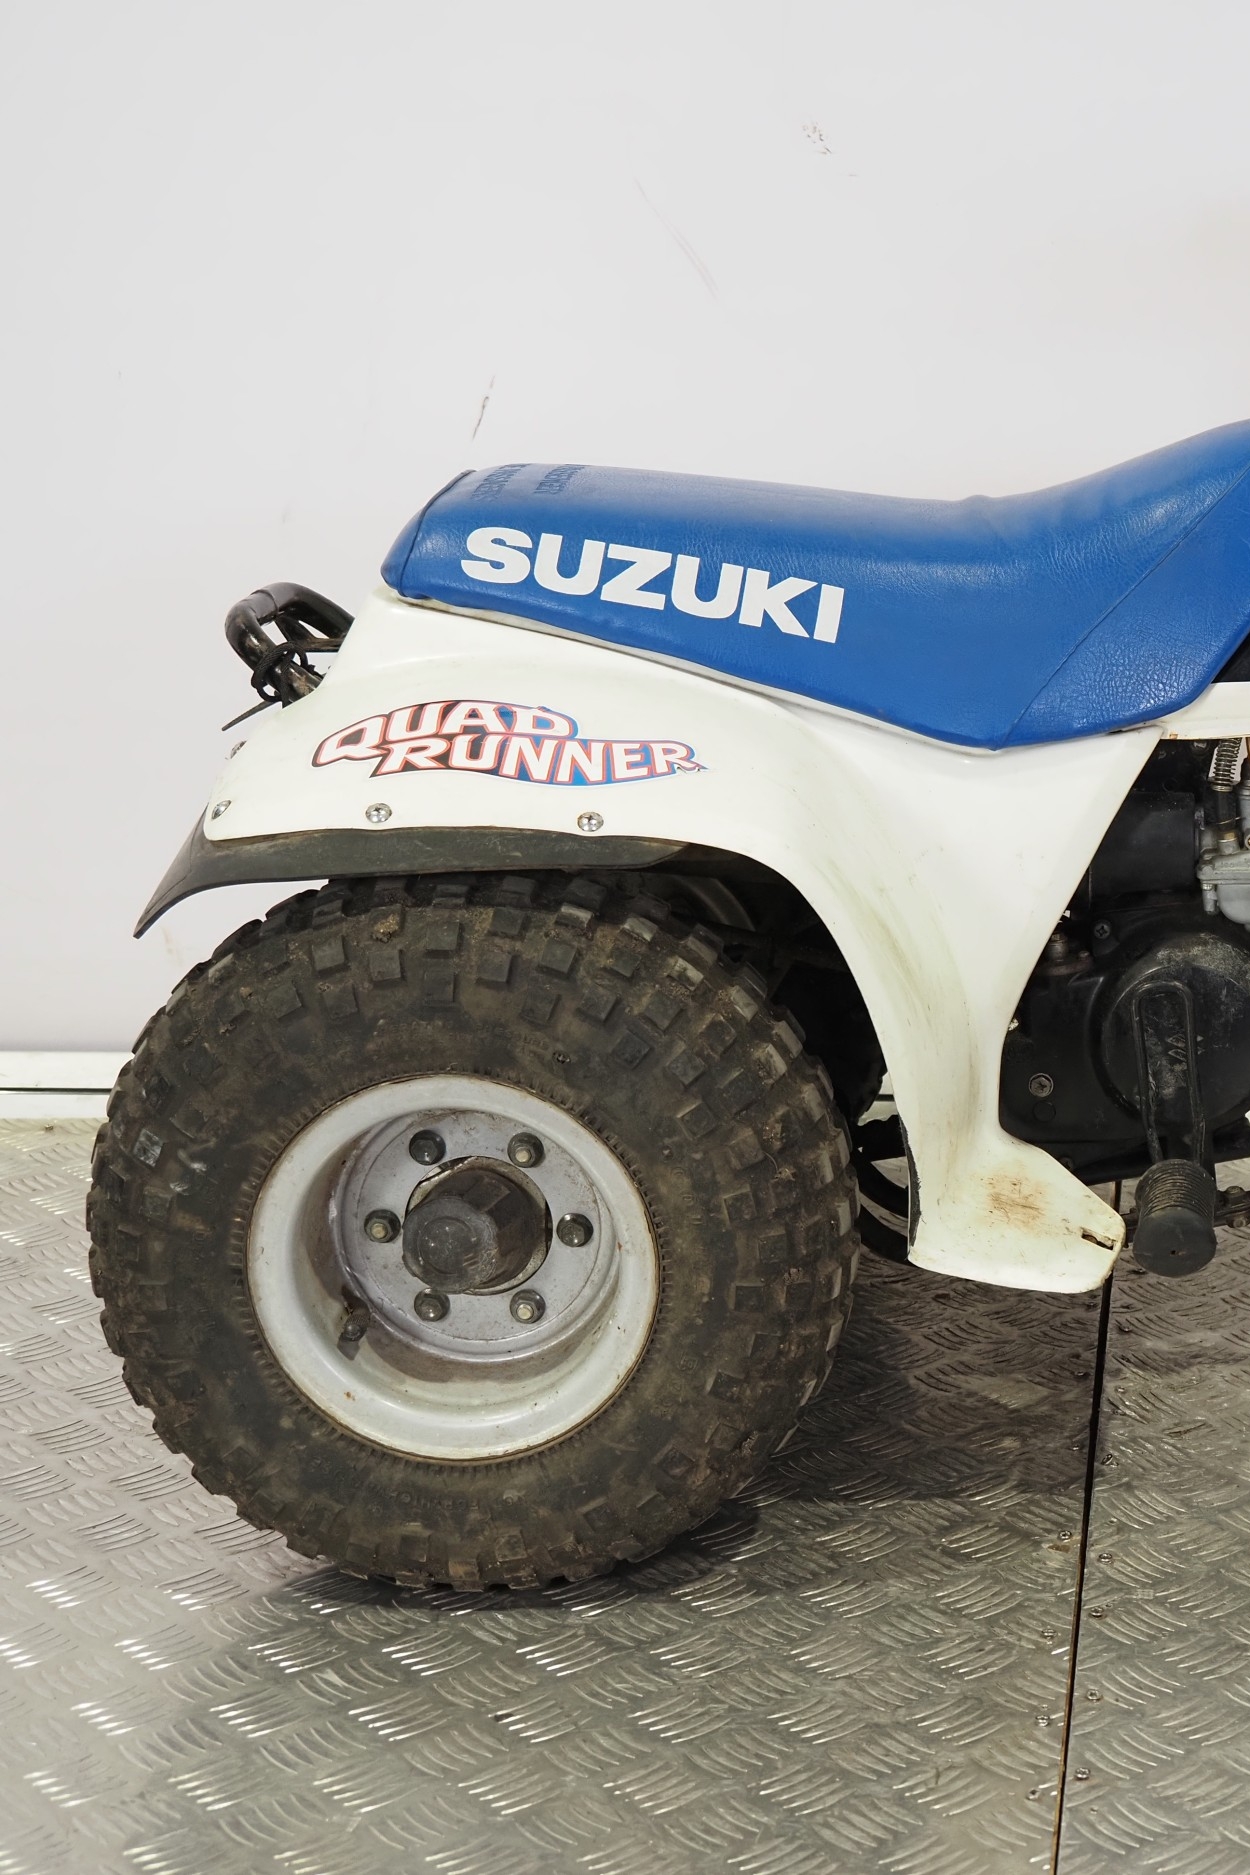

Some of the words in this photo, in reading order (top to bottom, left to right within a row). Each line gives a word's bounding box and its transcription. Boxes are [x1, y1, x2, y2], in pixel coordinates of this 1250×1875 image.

[461, 526, 844, 643] SUZUKI
[316, 701, 574, 763] QUAD
[377, 733, 699, 783] RUNNER
